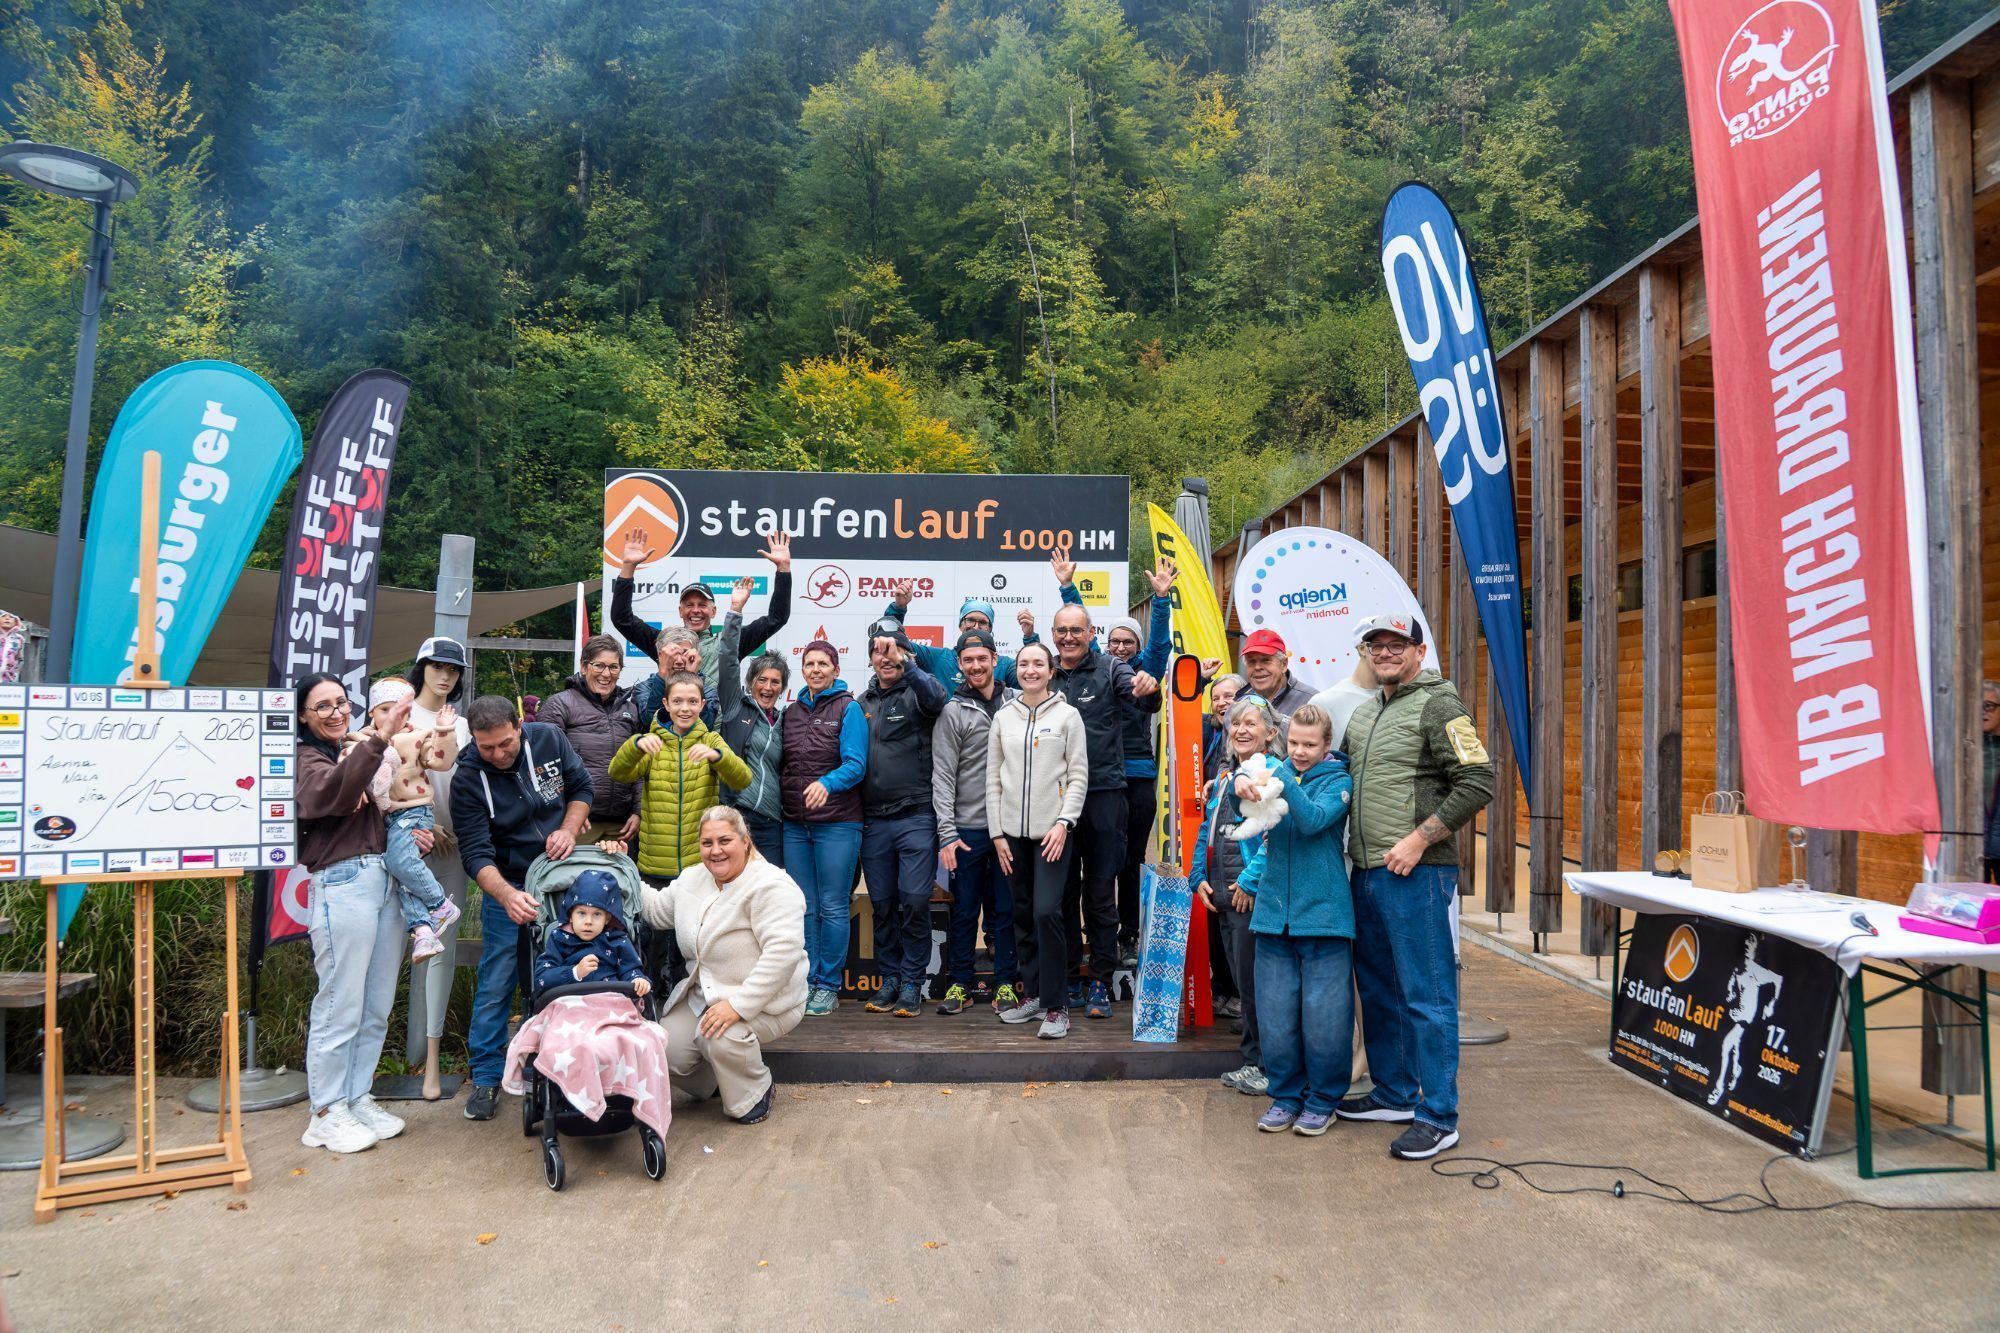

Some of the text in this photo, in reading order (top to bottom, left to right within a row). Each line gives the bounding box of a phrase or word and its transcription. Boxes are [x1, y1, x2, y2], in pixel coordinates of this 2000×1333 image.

[700, 497, 999, 539] staufenlauf
[1000, 529, 1115, 550] 1000 HM
[40, 715, 255, 741] Staufenlauf 2026
[1626, 977, 1725, 1032] staufenlauf
[1653, 1019, 1696, 1048] 1000 HM
[1766, 1024, 1789, 1053] 17.
[1761, 1048, 1800, 1075] Oktober
